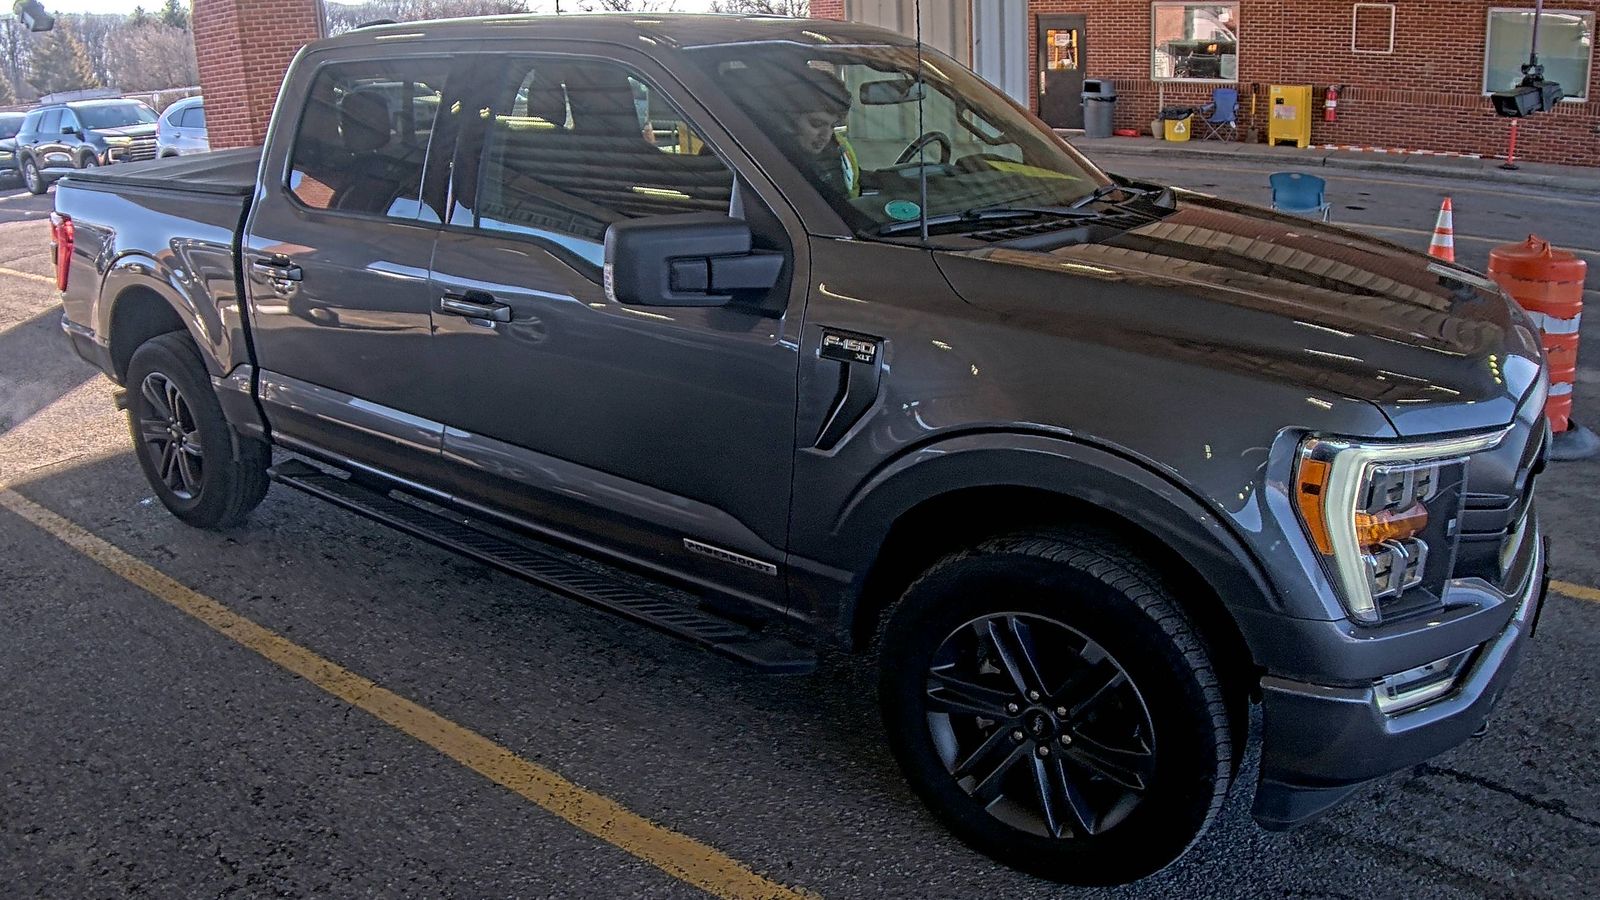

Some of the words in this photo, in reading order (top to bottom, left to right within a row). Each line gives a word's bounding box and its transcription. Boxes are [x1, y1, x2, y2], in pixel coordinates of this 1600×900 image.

[824, 335, 875, 354] F-150
[855, 353, 871, 361] XLT
[686, 541, 771, 572] POWERBOOST
